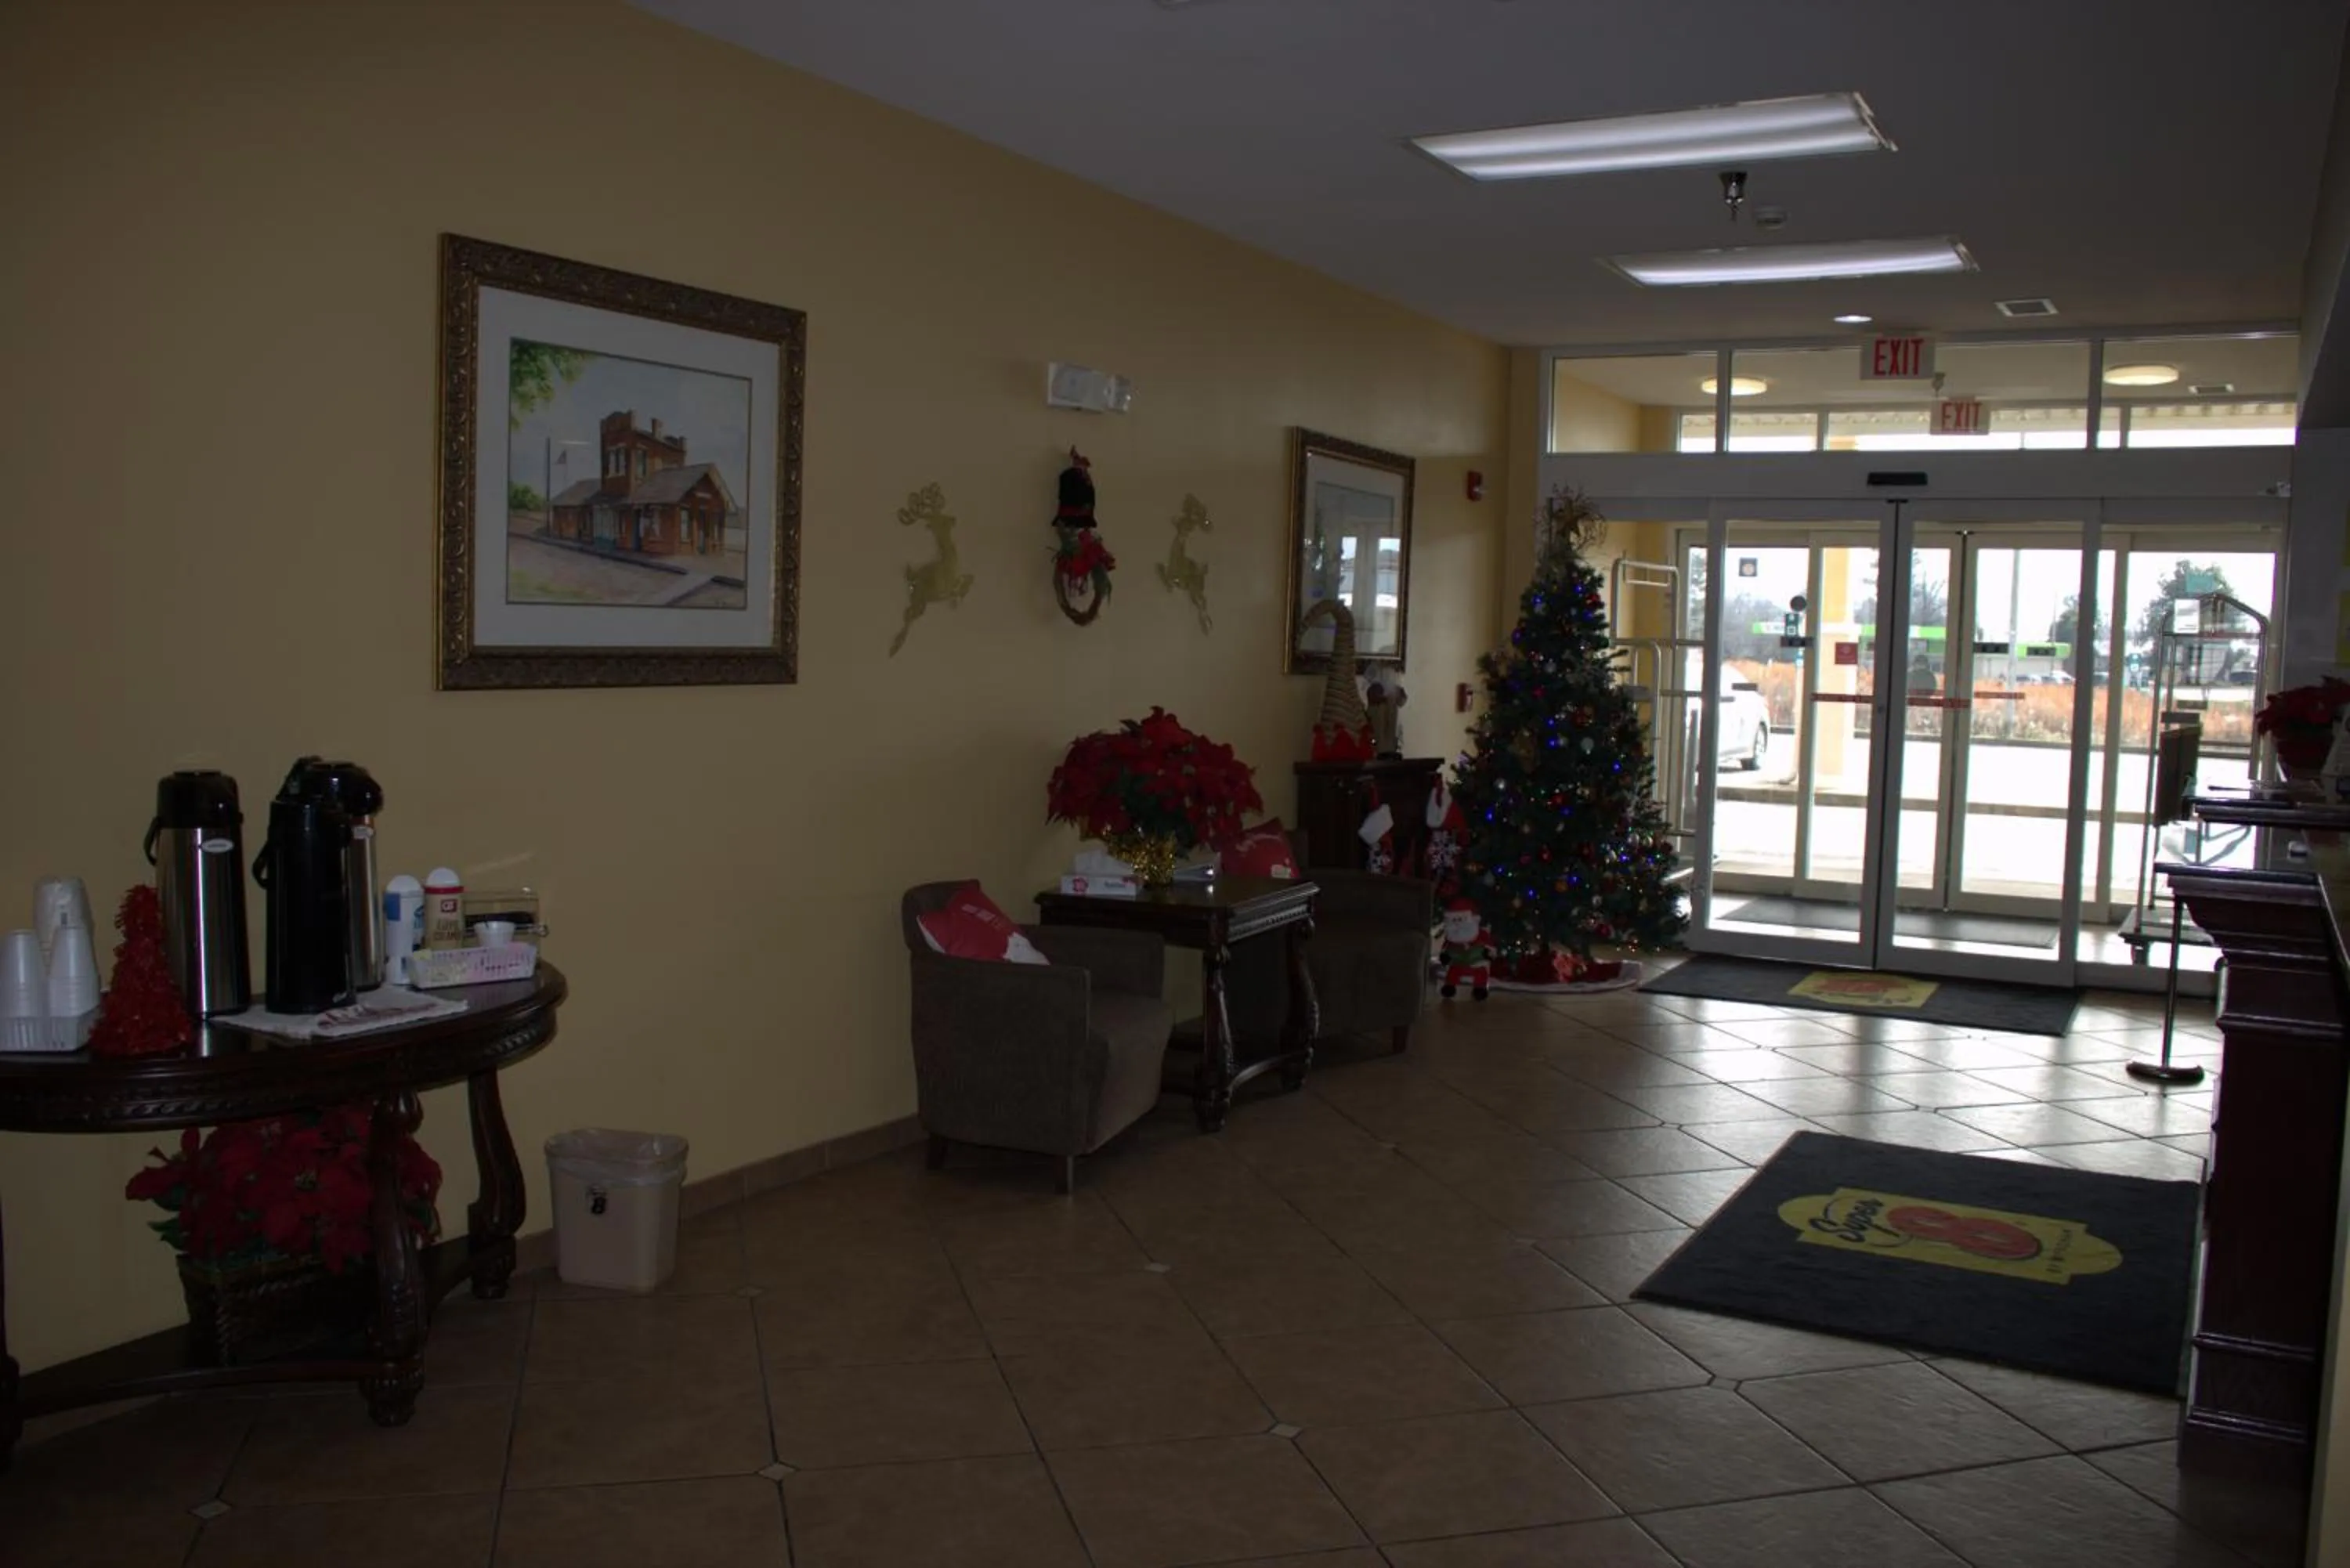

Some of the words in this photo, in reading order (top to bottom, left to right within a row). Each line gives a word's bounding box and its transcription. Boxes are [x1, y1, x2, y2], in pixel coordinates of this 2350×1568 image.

[1874, 338, 1925, 376] EXIT
[1941, 402, 1983, 429] EXIT
[1808, 1198, 1900, 1243] Super
